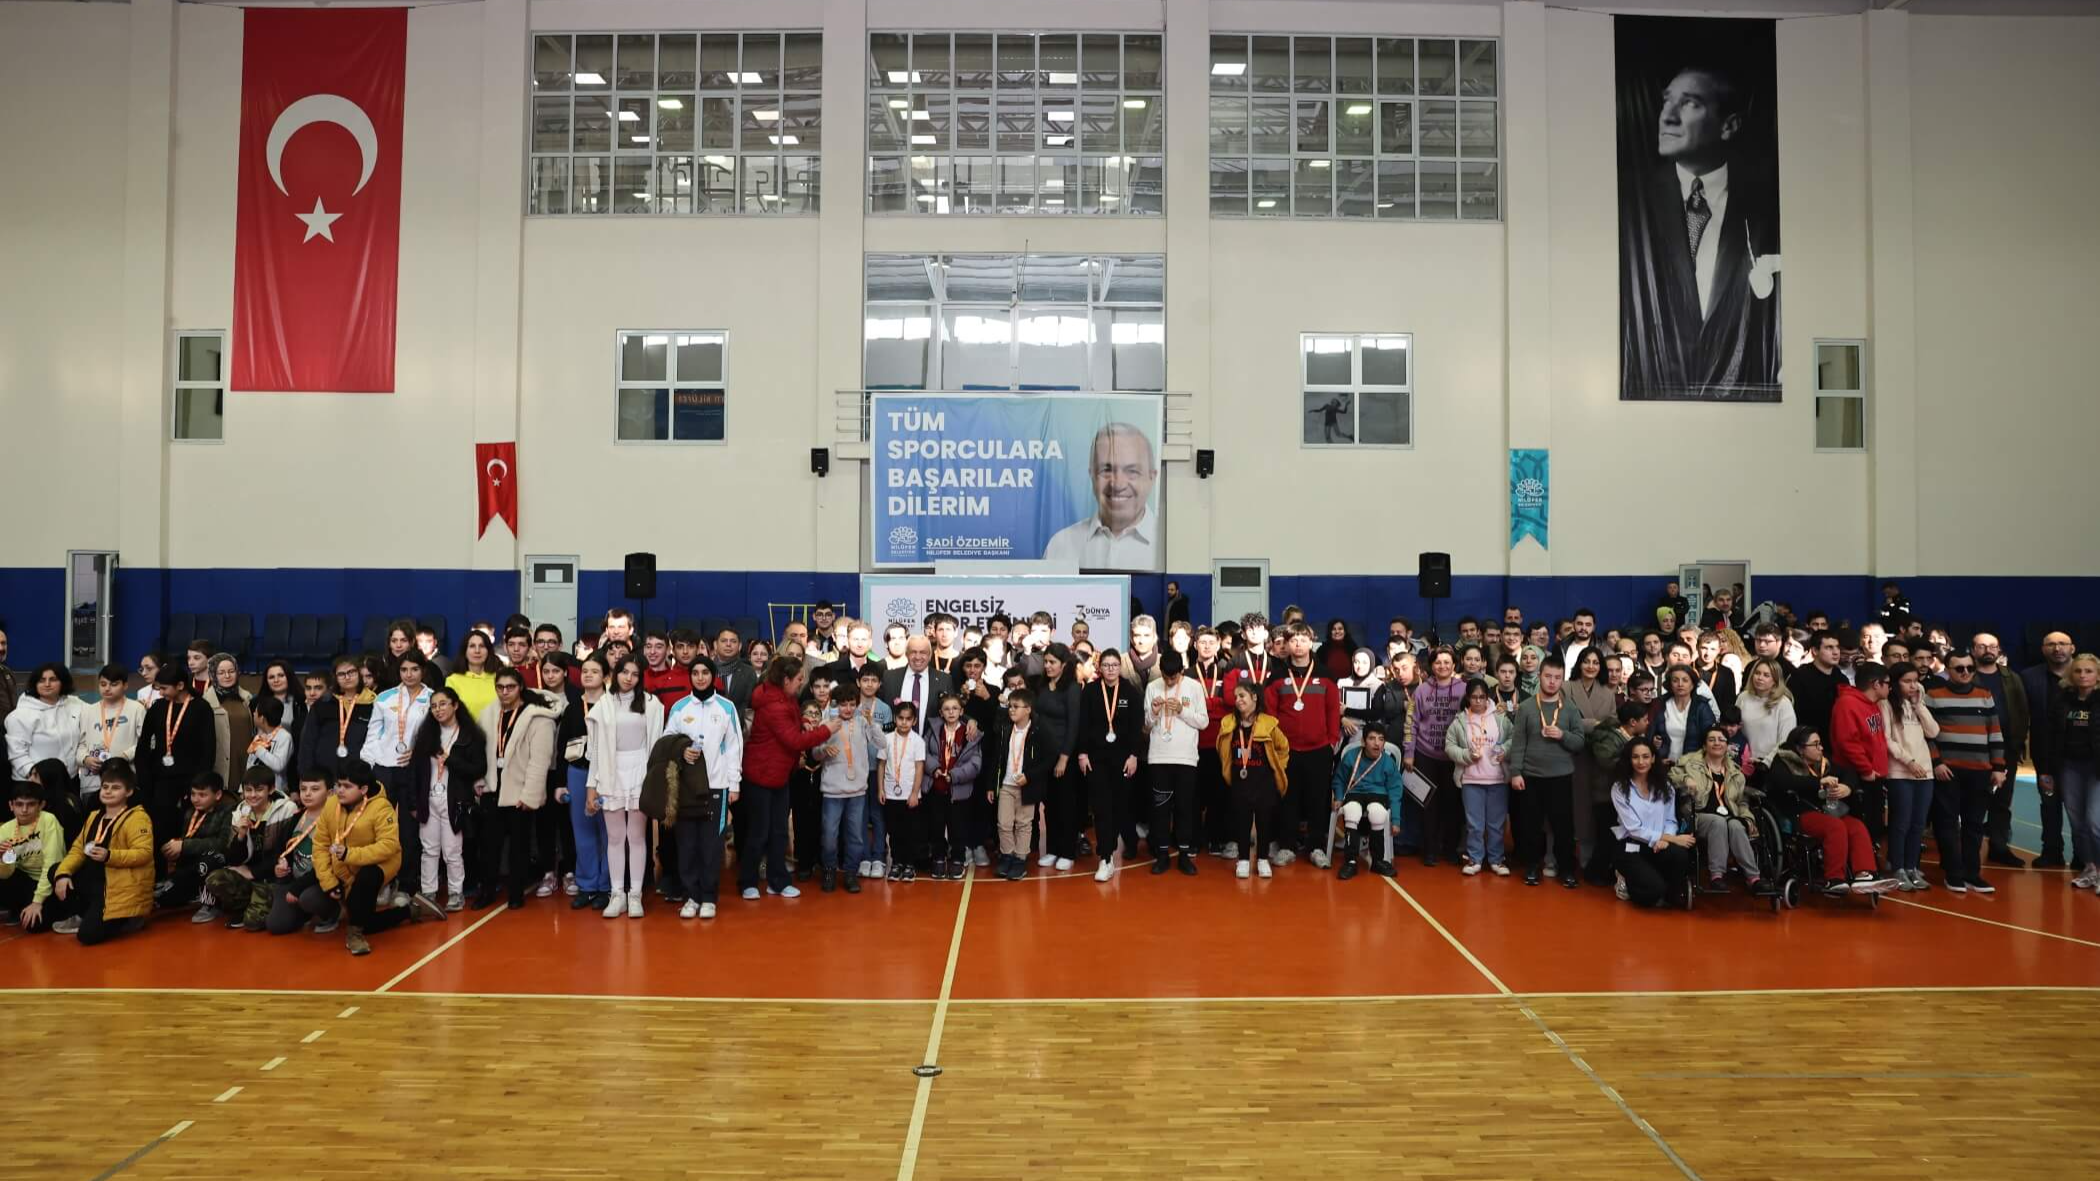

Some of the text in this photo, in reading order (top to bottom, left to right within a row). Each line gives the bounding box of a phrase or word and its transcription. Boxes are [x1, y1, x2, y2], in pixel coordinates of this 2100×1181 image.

[888, 407, 945, 432] TÜM
[887, 440, 1063, 460] SPORCULARA
[888, 468, 1034, 495] BAŞARILAR
[888, 491, 990, 516] DİLERİM
[926, 535, 1010, 549] ŞADİ ÖZDEMİR
[926, 595, 1005, 613] ENGELSİZ
[1085, 606, 1110, 615] DÜNYA
